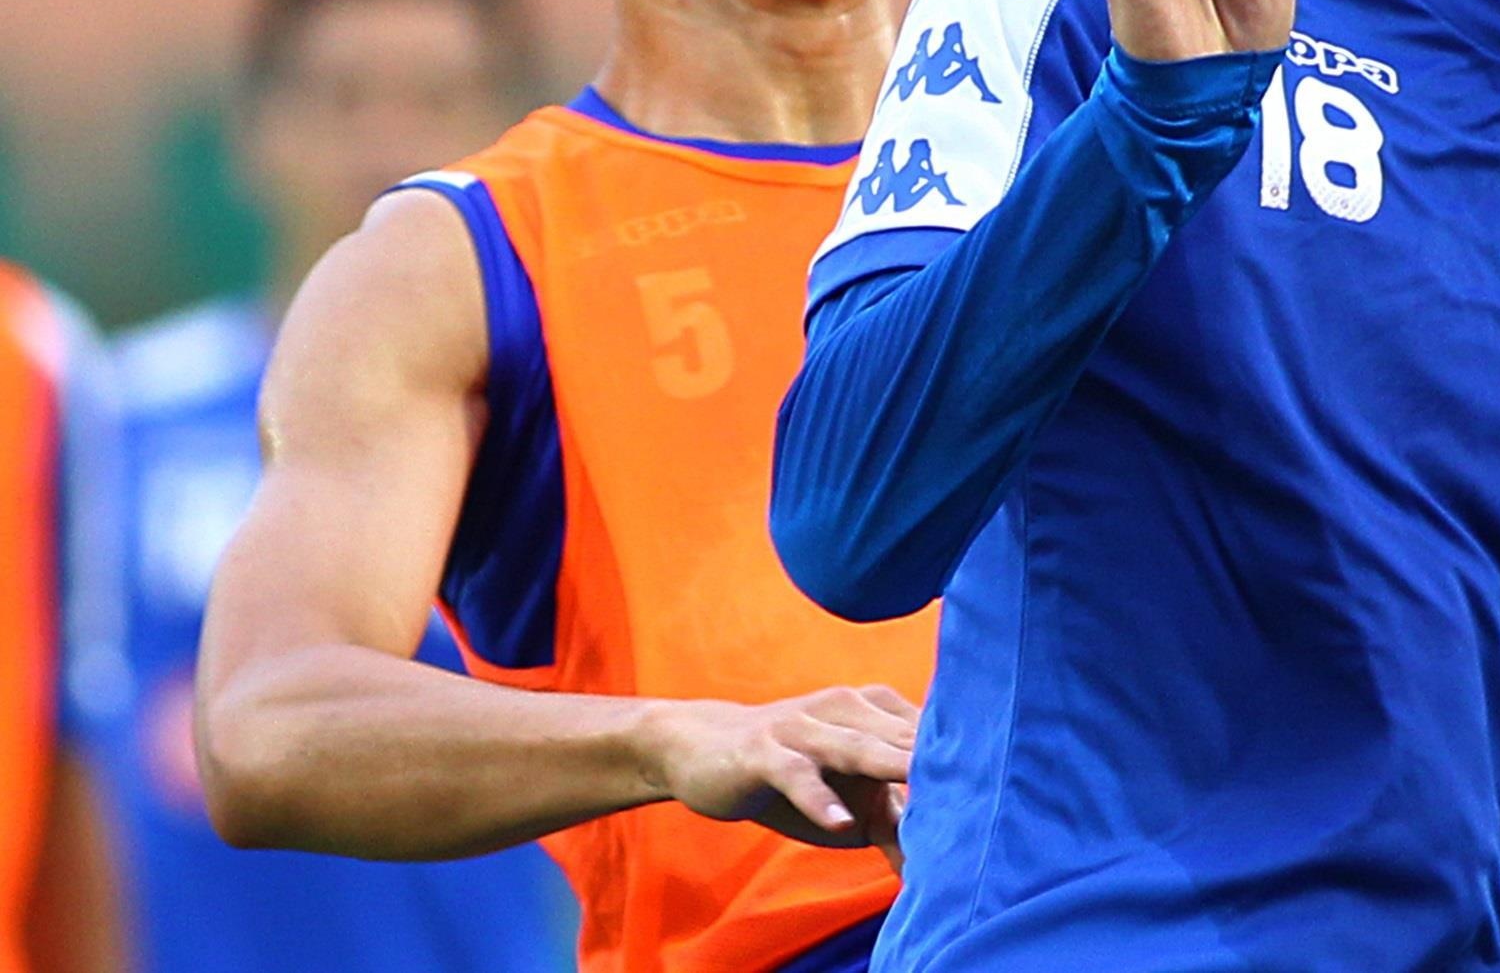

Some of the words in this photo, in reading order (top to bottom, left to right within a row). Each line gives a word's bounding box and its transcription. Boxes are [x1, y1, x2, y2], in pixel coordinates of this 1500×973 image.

[1285, 30, 1400, 95] ppa
[1260, 63, 1384, 223] 18
[634, 267, 735, 400] 5
